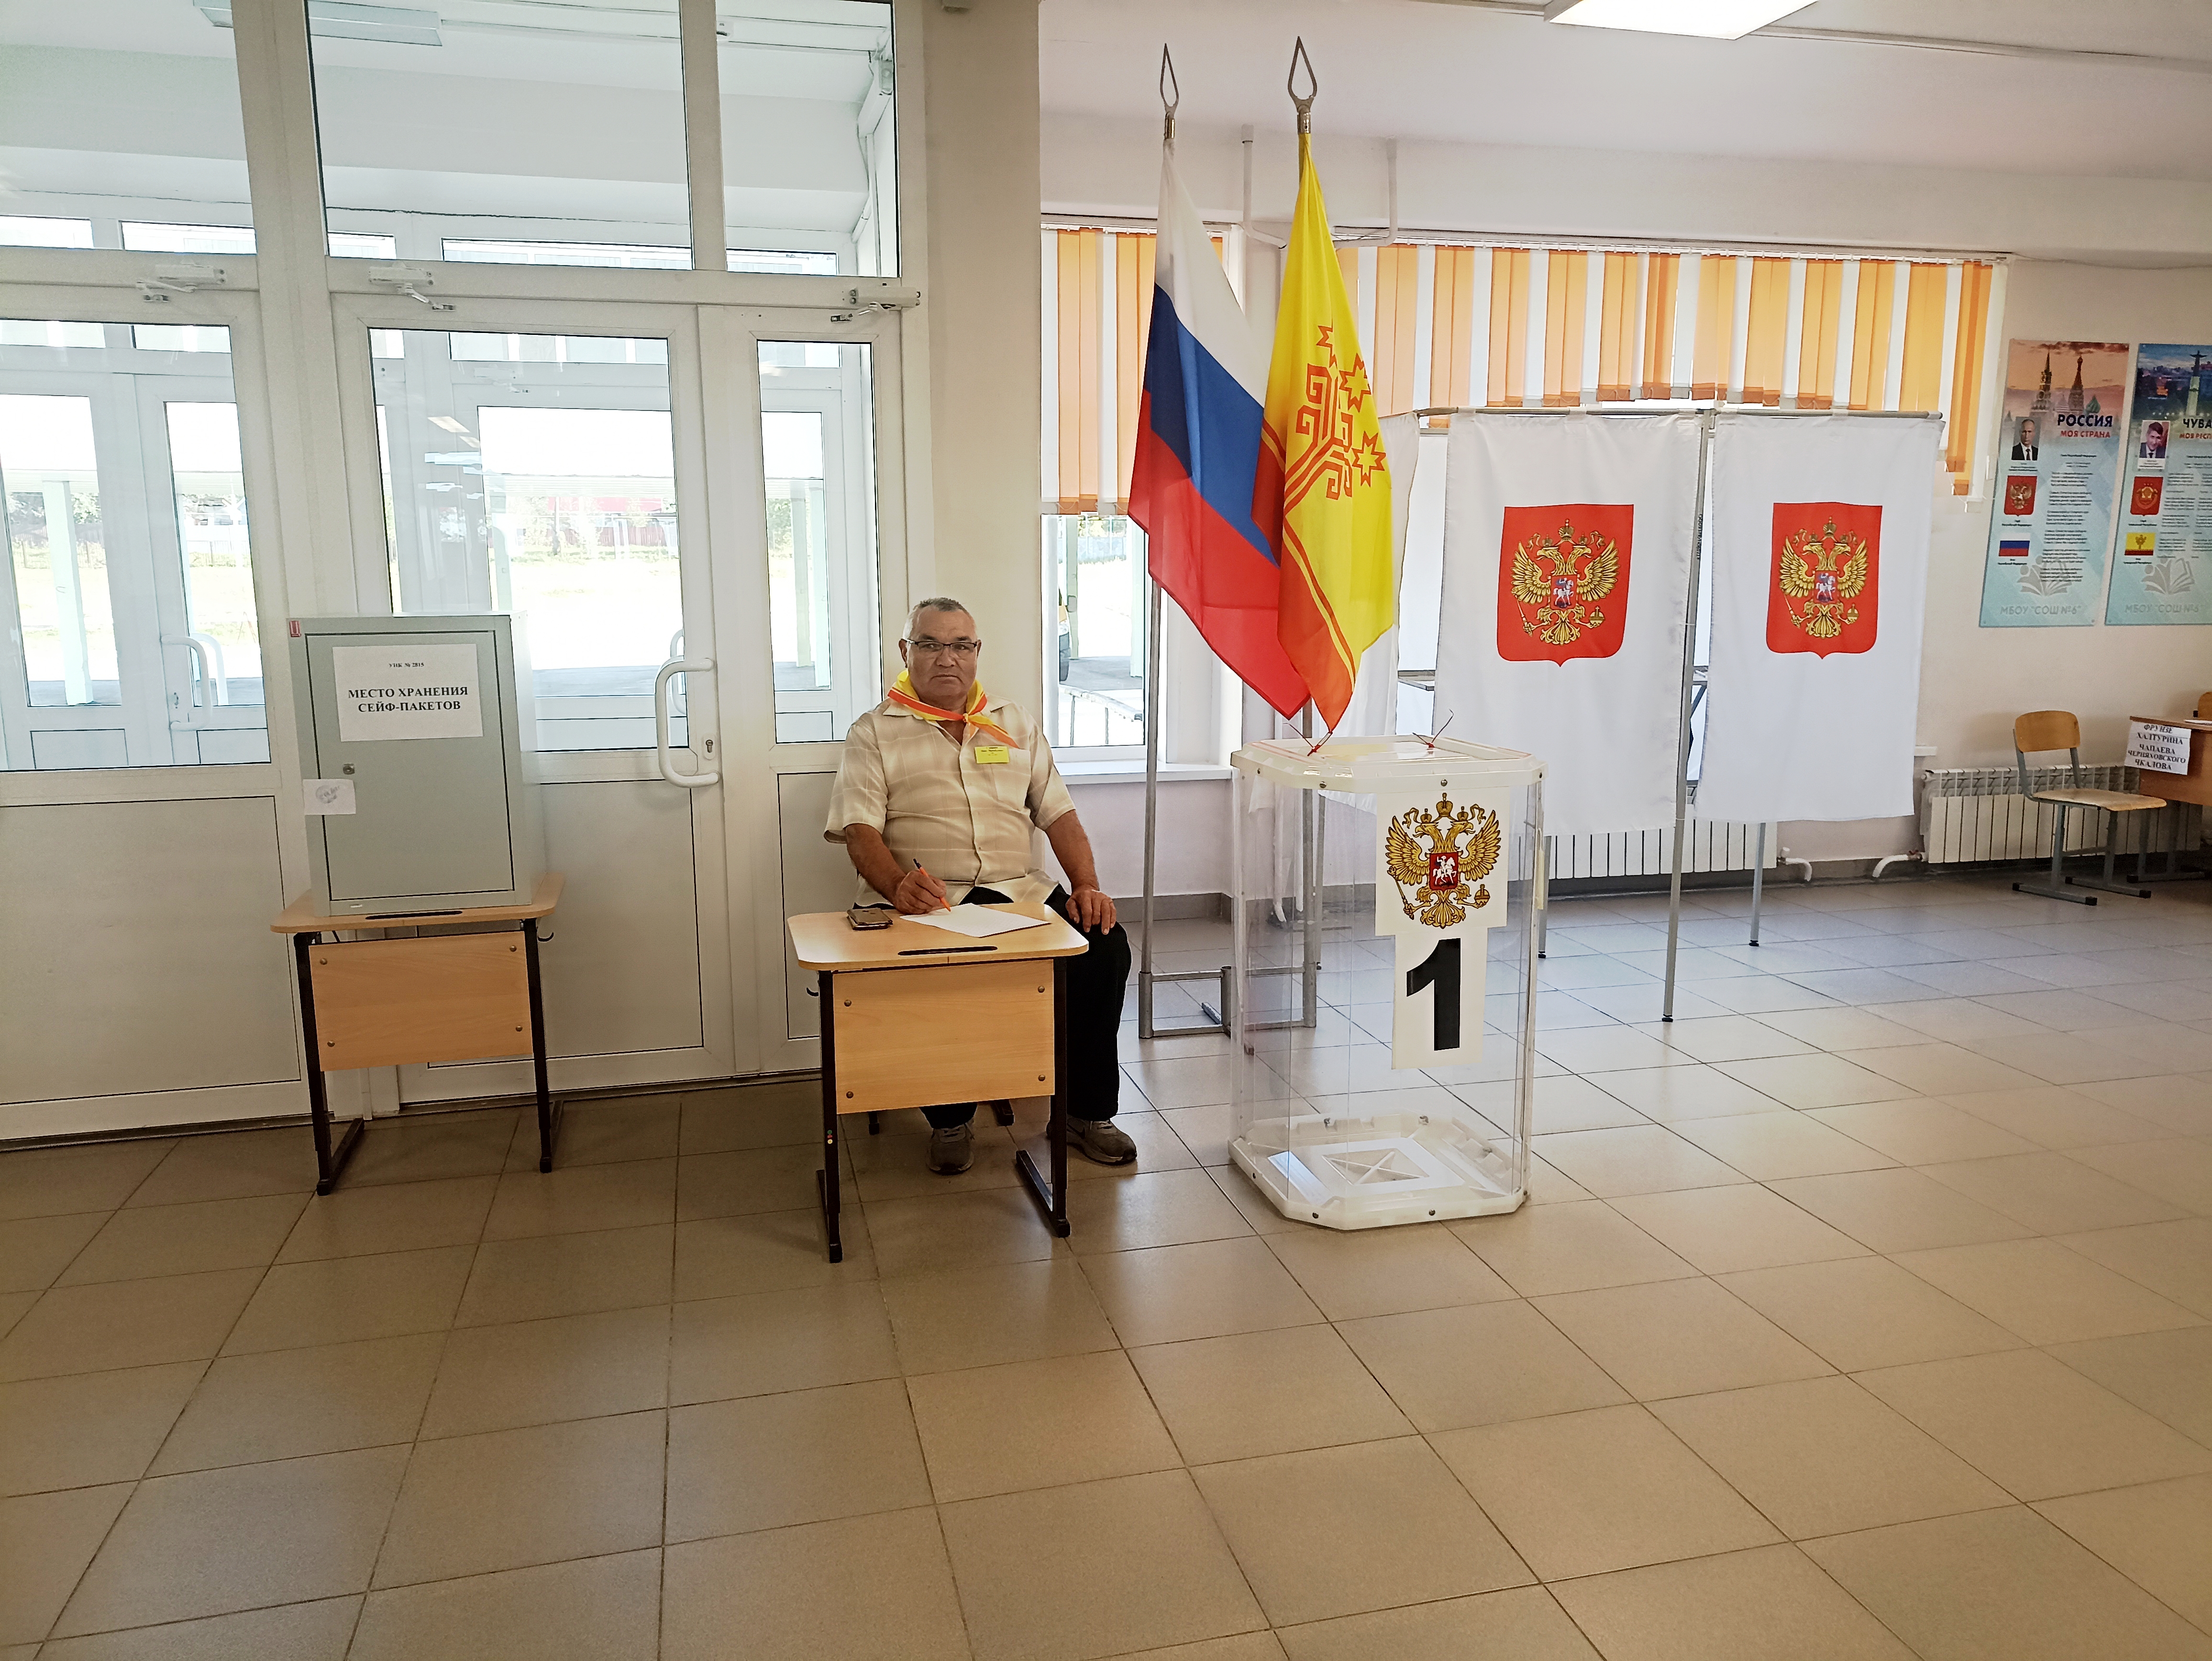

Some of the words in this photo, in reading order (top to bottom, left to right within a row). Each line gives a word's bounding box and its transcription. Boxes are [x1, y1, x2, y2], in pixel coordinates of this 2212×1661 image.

[2057, 414, 2113, 427] РОССИЯ
[2183, 418, 2212, 429] ЧУВА
[2000, 605, 2029, 615] МБОУ
[348, 688, 395, 698] МЕСТО
[398, 687, 468, 697] ХРАНЕНИЯ
[358, 700, 461, 712] СЕЙФ-ПАКЕТОВ
[2144, 724, 2173, 733] ФРУНЗЕ
[2139, 743, 2176, 755] ЧАПАЕВА
[2128, 750, 2186, 764] ЧЕРНЯХОВСКОГО
[2135, 759, 2172, 770] ЧКАЛОВА
[1406, 938, 1461, 1051] 1
